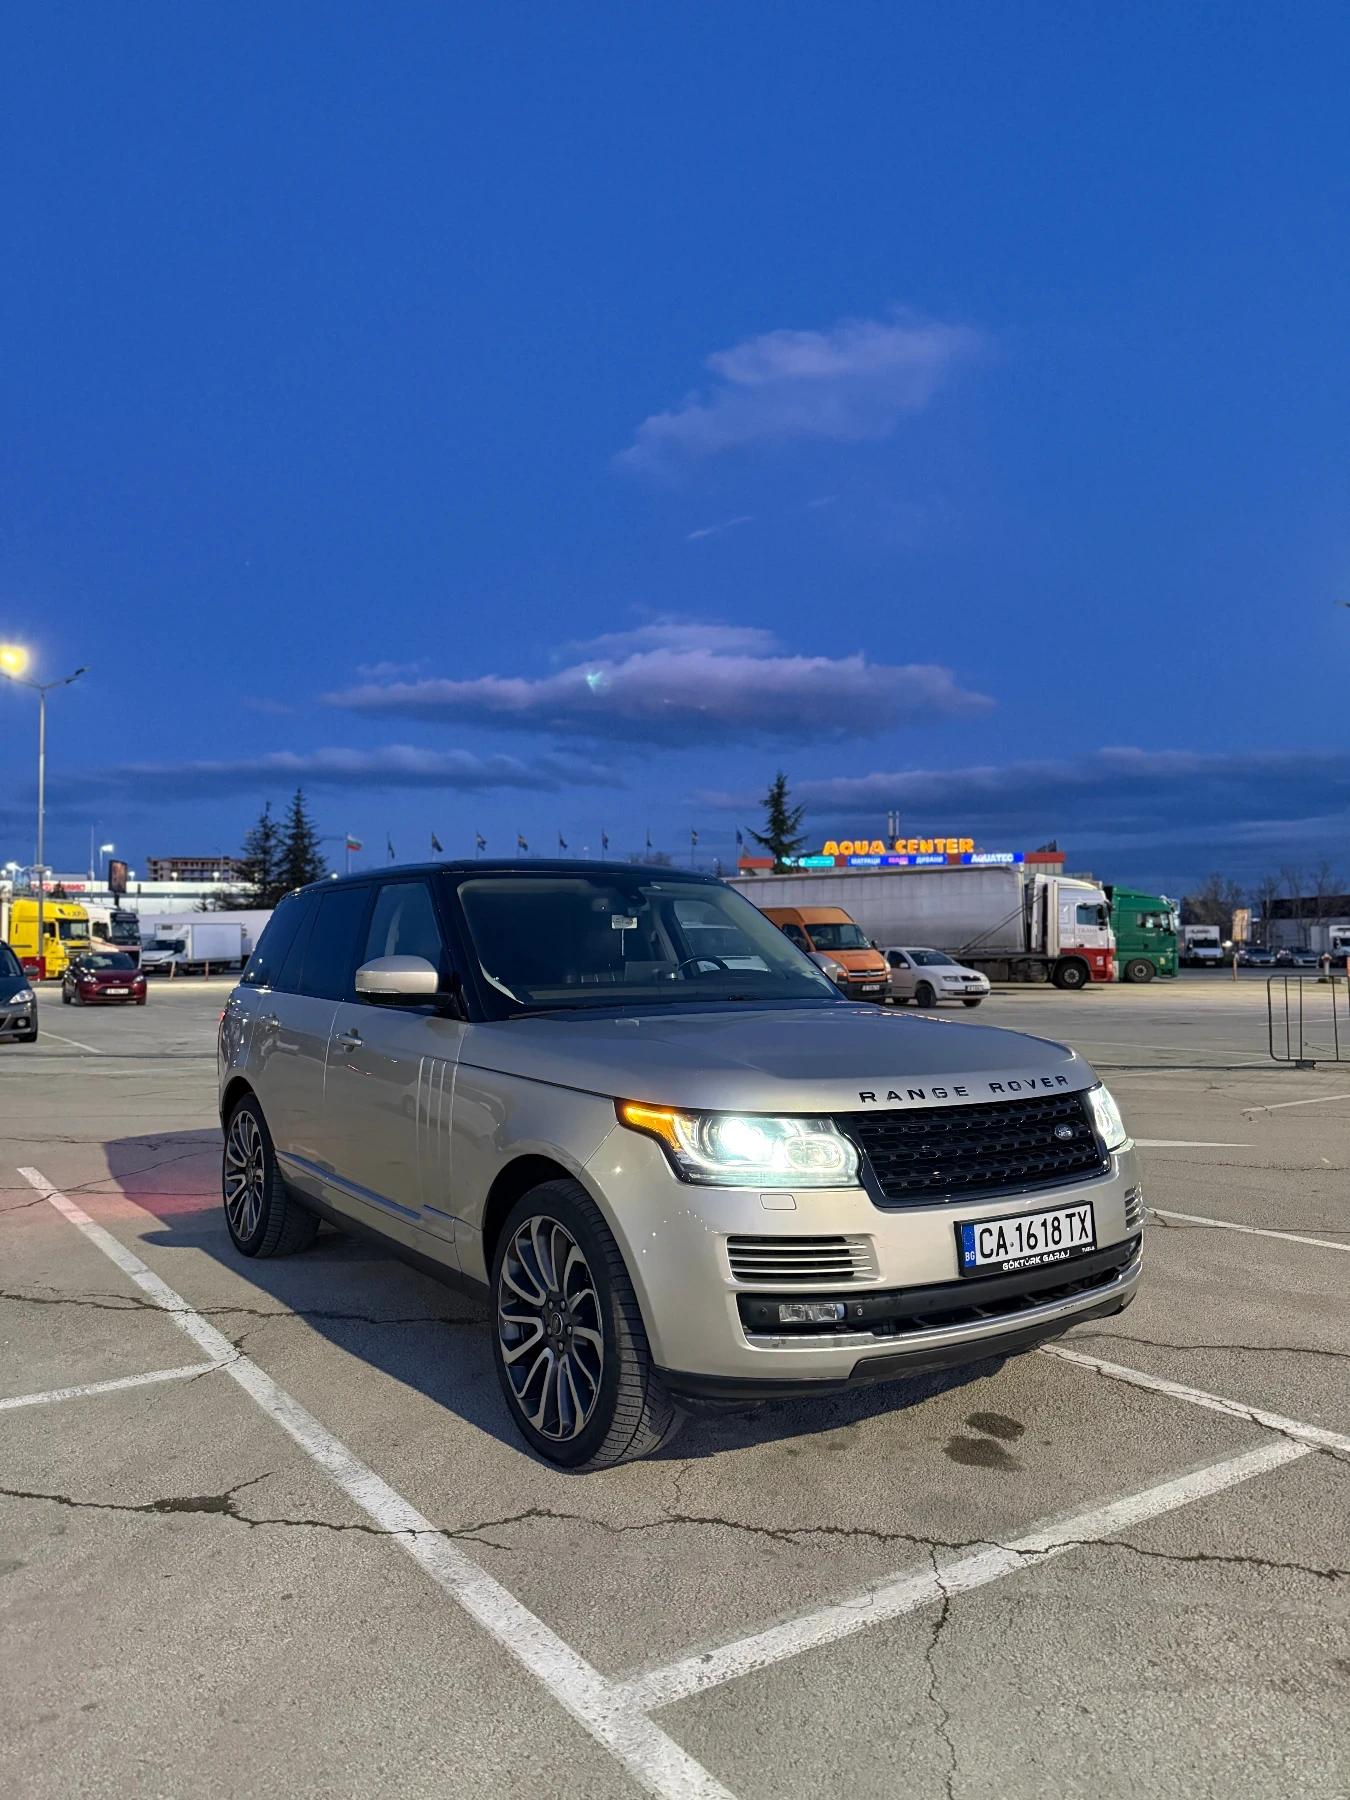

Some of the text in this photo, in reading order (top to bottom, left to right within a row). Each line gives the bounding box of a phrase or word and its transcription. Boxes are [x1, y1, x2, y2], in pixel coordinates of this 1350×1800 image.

[822, 838, 975, 856] AQUA CENTER
[970, 853, 1014, 863] AQUATEC
[858, 1075, 1069, 1103] RANGE ROVER
[965, 1251, 976, 1262] BG
[1042, 1249, 1070, 1262] GARAJ
